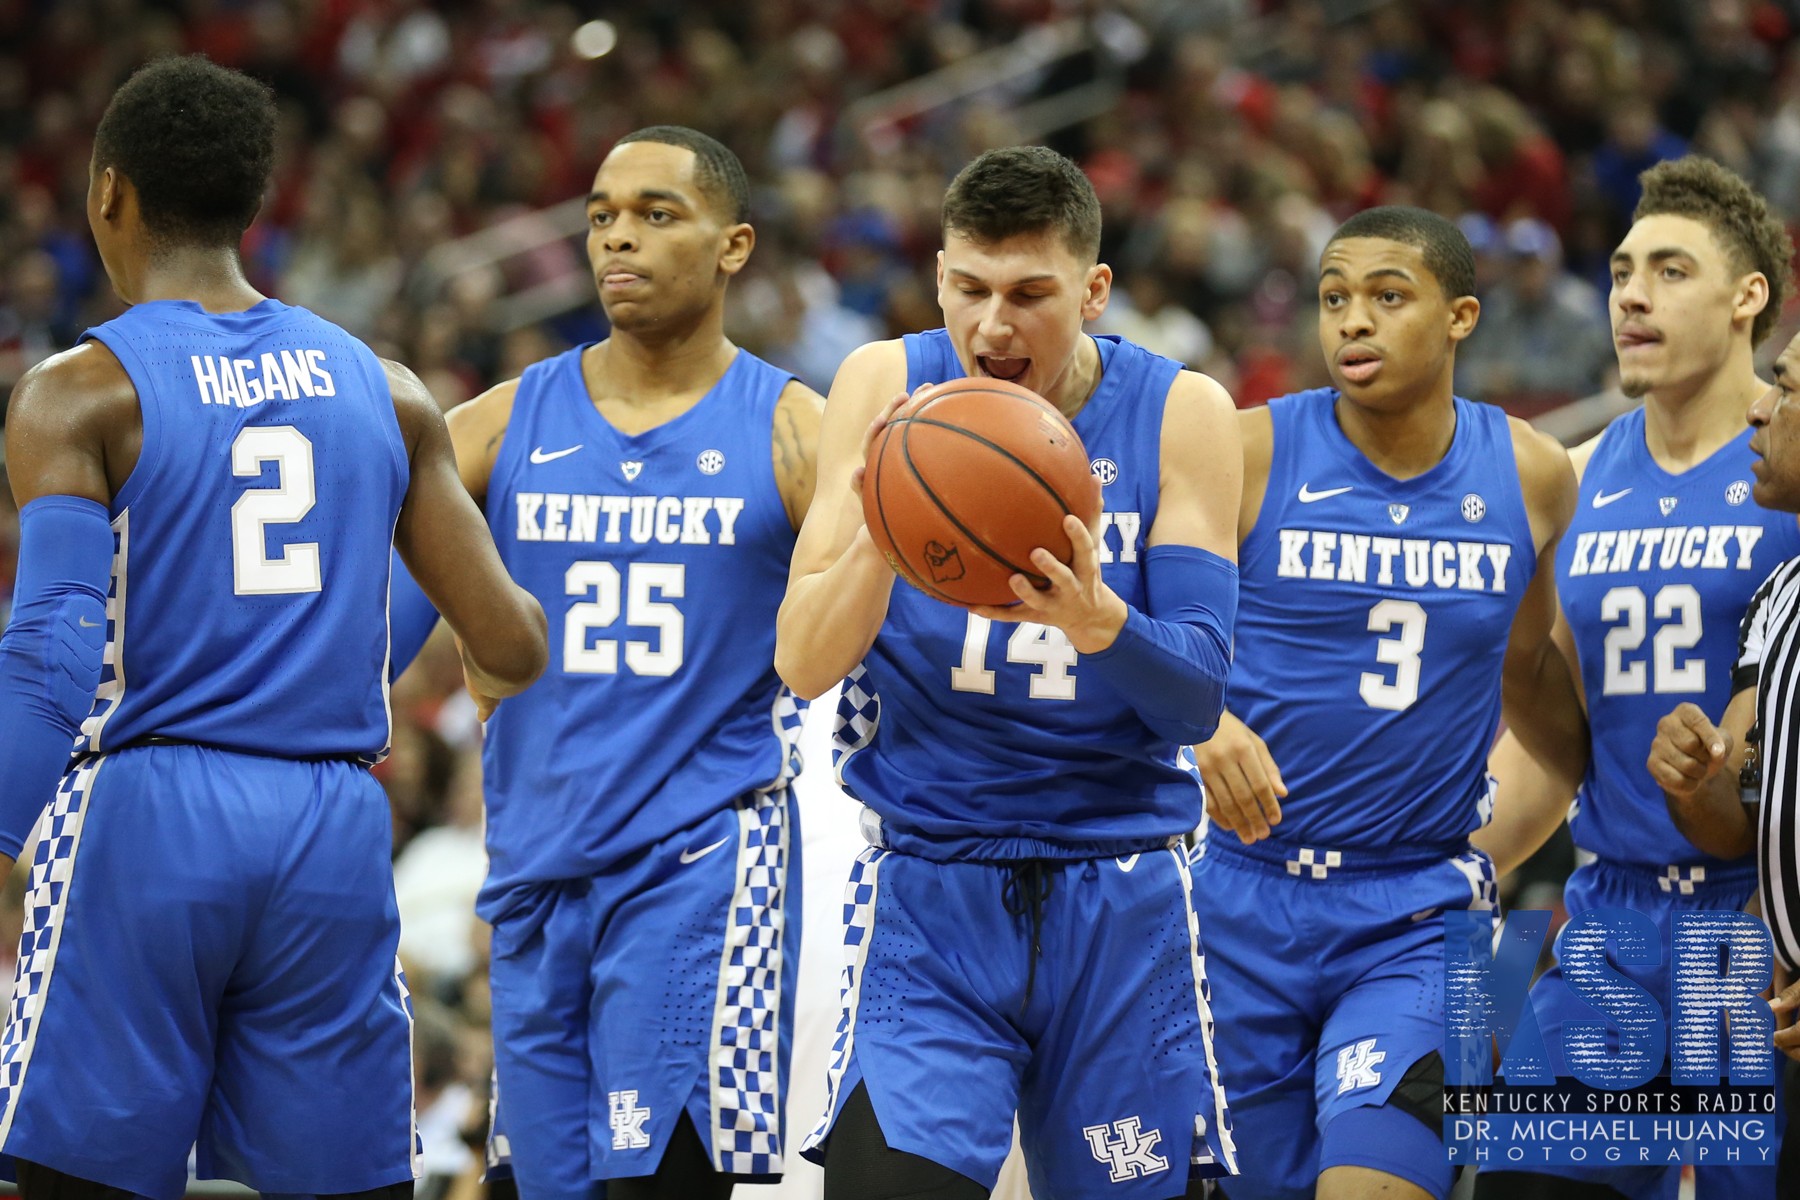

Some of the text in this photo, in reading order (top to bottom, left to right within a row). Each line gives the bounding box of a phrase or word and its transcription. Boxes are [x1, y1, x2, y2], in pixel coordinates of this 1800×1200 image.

[191, 349, 336, 408] HAGANS
[697, 449, 725, 475] SEC
[1090, 457, 1118, 486] SEC
[231, 425, 322, 596] 2
[516, 492, 745, 545] KENTUCKY
[1461, 493, 1486, 523] SEC
[1725, 480, 1750, 506] SEC
[1277, 529, 1512, 592] KENTUCKY
[1568, 525, 1764, 577] KENTUCKY
[563, 561, 686, 677] 25
[1601, 583, 1706, 696] 22
[951, 611, 1078, 700] 14
[1359, 598, 1428, 711] 3
[1336, 1038, 1386, 1095] UK
[608, 1089, 651, 1150] UK
[1083, 1115, 1169, 1183] UK
